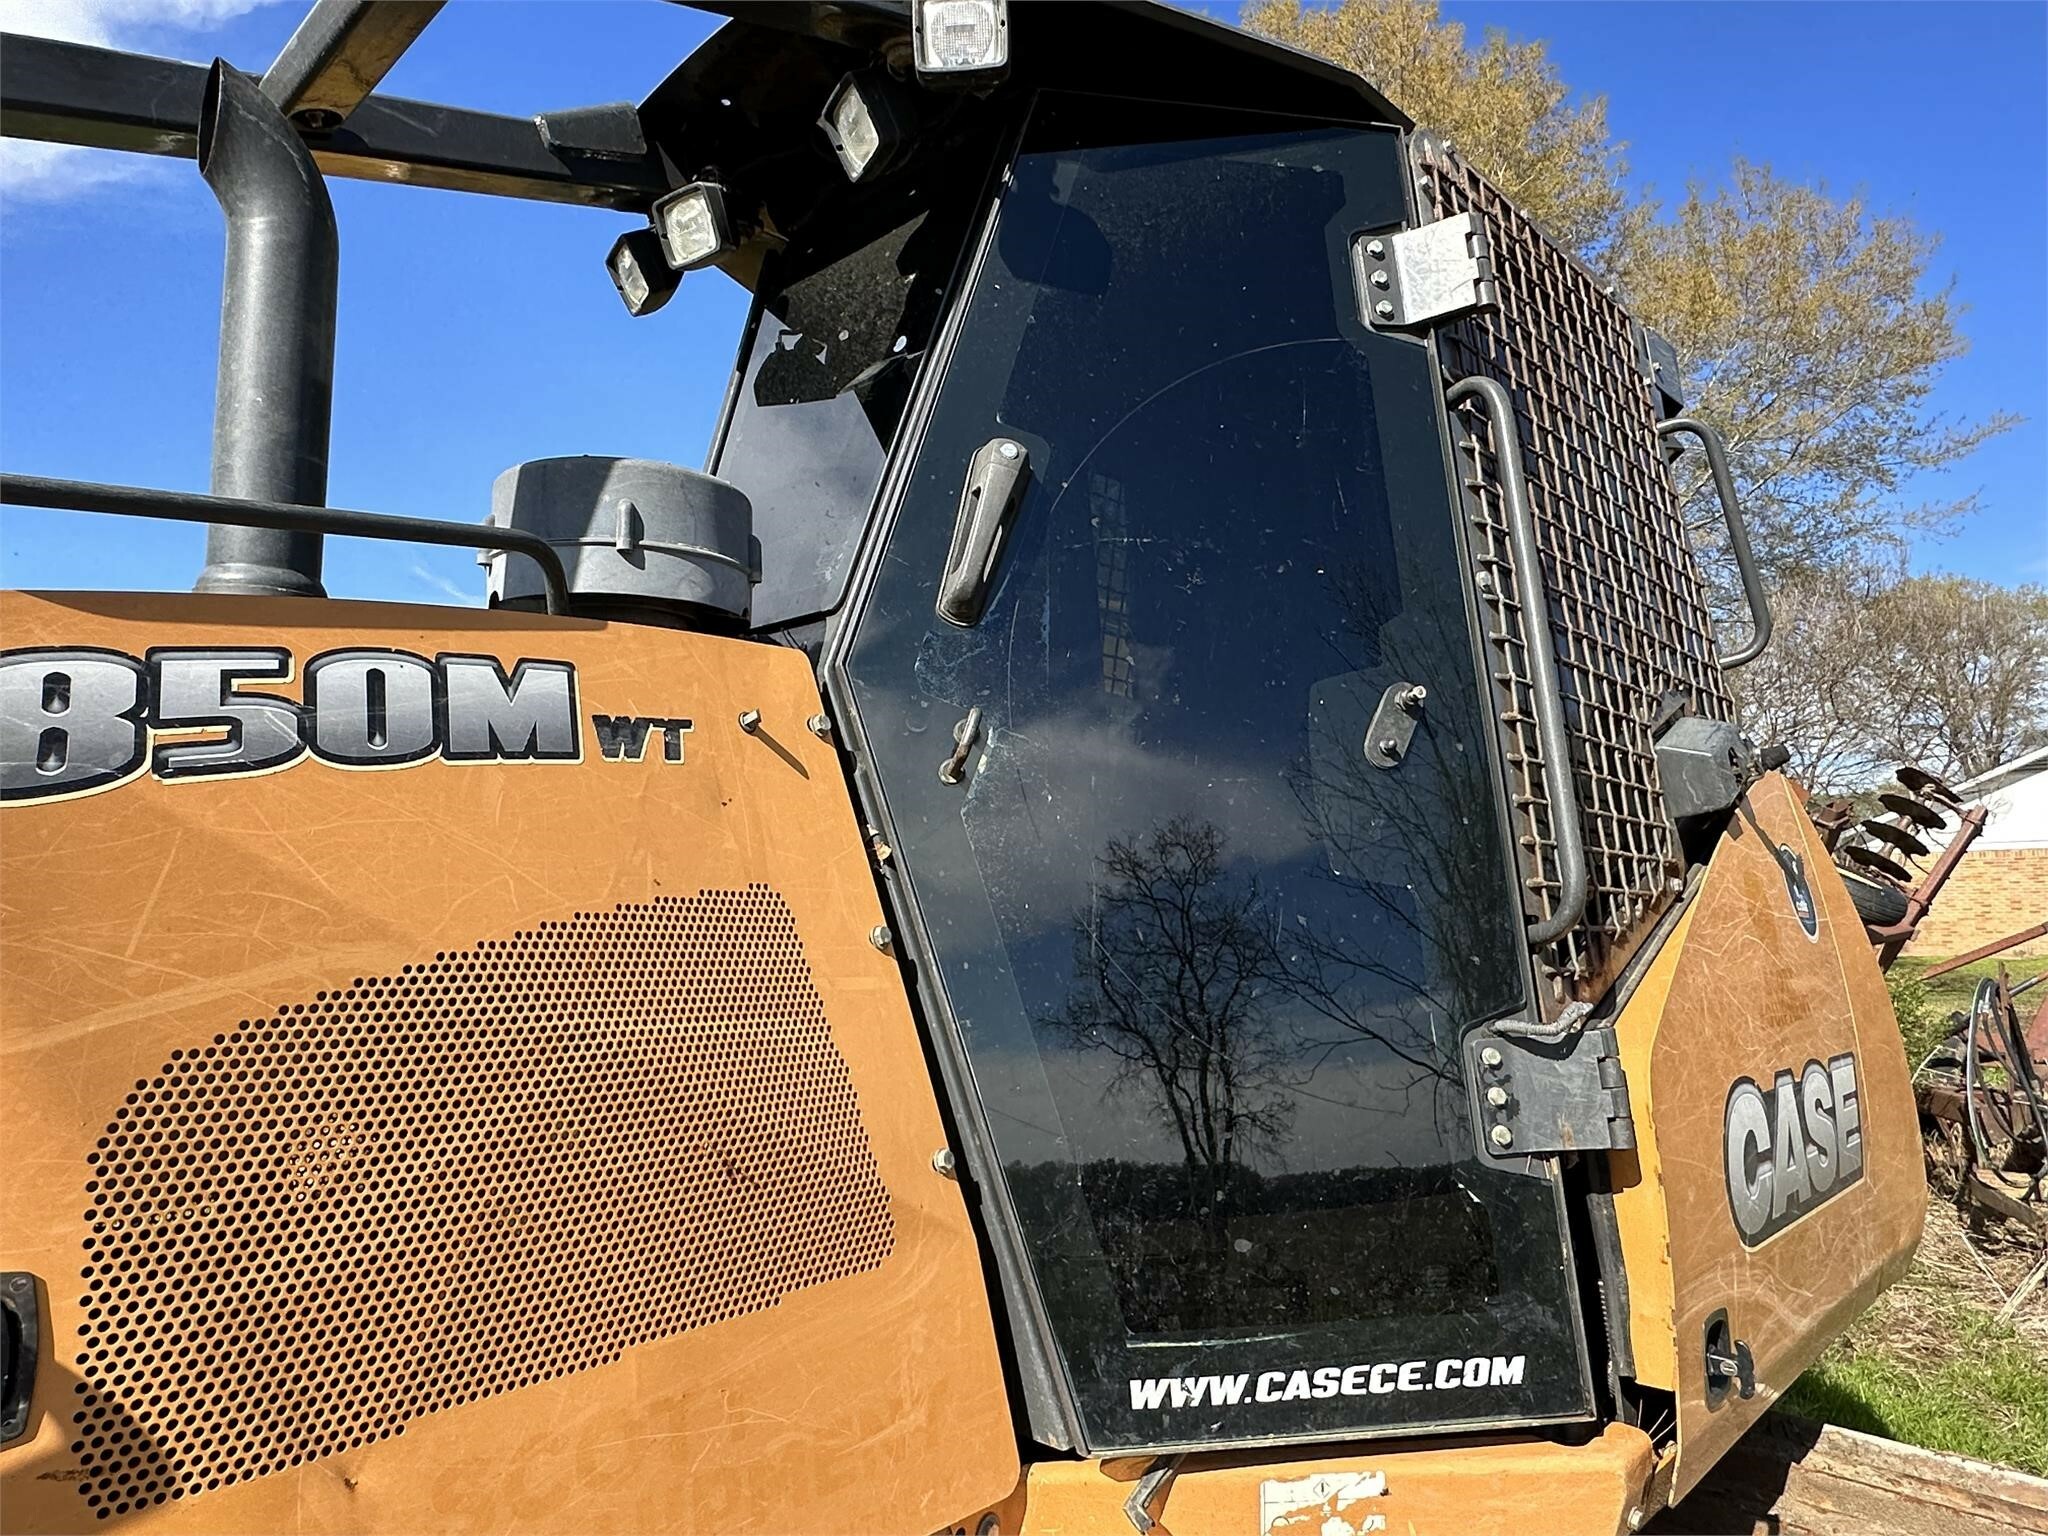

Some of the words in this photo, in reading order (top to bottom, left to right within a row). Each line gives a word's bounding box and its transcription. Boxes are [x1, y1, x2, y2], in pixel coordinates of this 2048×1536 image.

[0, 647, 583, 804] 850M
[591, 714, 693, 762] WT
[1725, 1053, 1863, 1244] CASE
[1129, 1355, 1526, 1410] WWW.CASECE.COM
